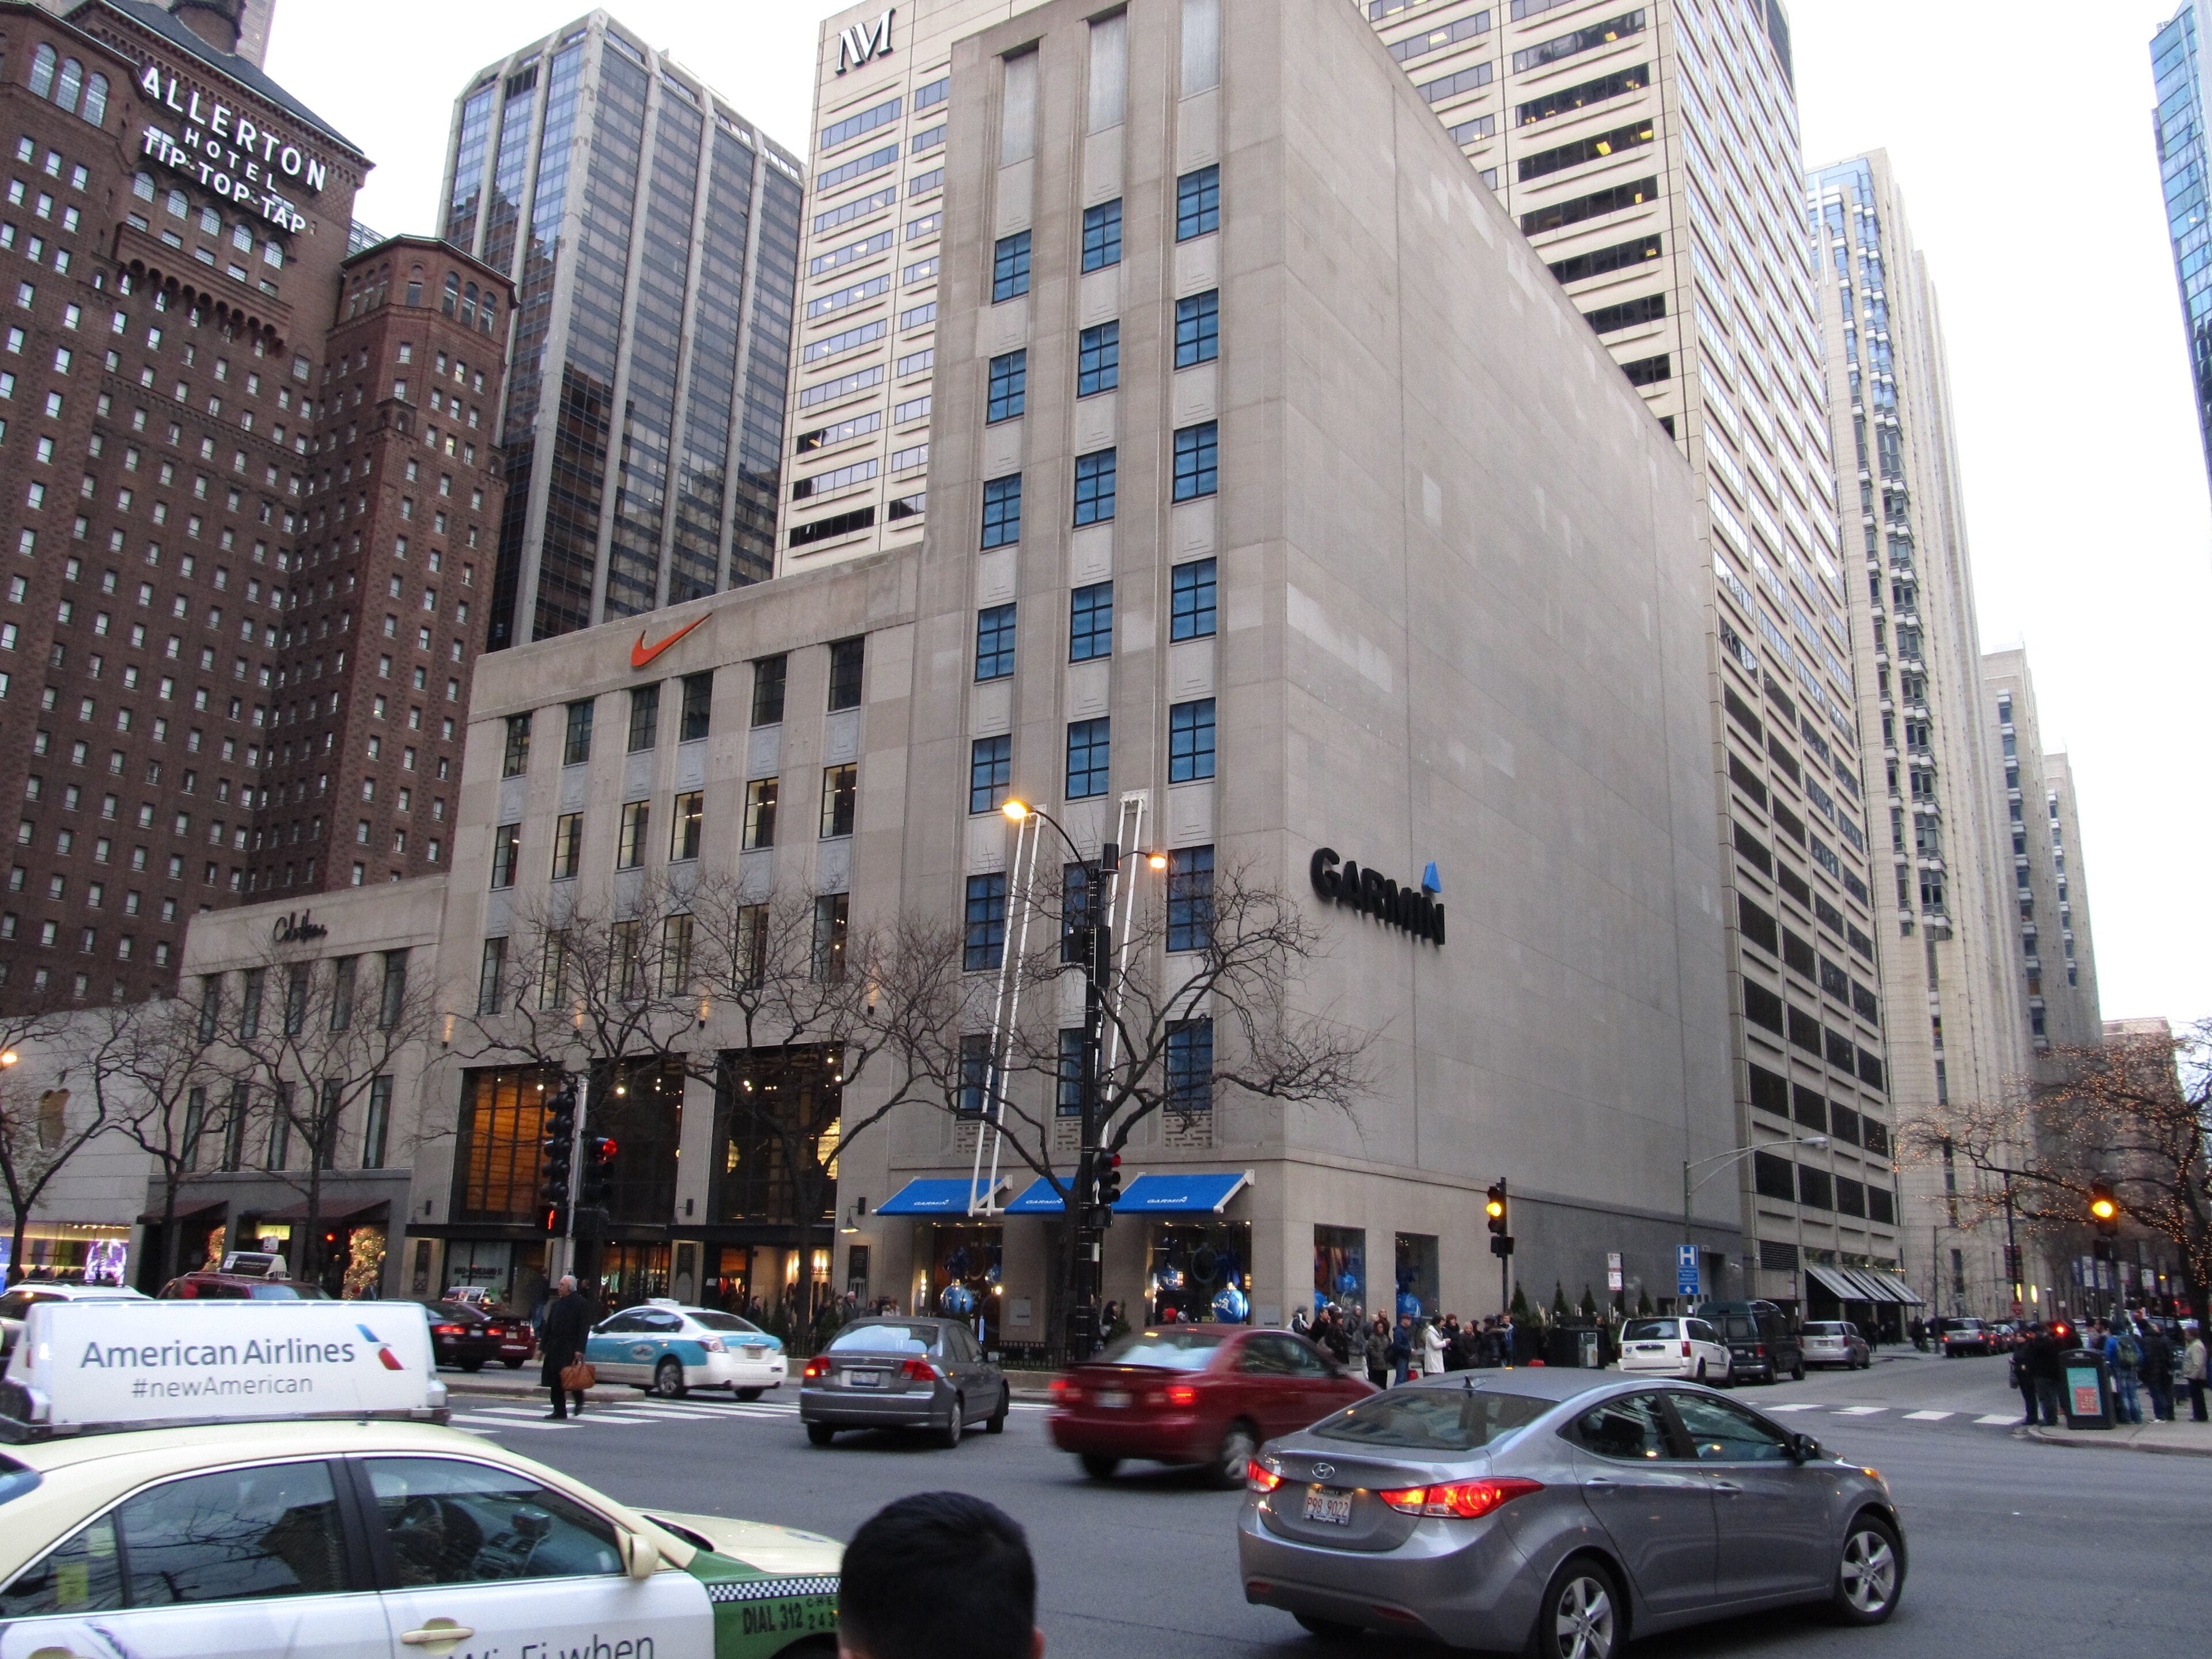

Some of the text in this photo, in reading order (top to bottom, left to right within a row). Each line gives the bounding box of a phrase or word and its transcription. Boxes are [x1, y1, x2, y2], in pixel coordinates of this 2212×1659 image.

[143, 66, 327, 192] ALLERTON
[184, 127, 277, 193] HOTEL
[143, 130, 306, 233] TIP TOP TAP
[1310, 847, 1445, 946] GARMIN
[1680, 1247, 1695, 1265] H
[80, 1338, 355, 1368] American Airlines
[131, 1374, 313, 1398] #newAmerican
[1307, 1497, 1349, 1517] P98 9022
[806, 1596, 834, 1608] CHE
[743, 1603, 804, 1635] DIAL 312
[808, 1611, 836, 1630] 243
